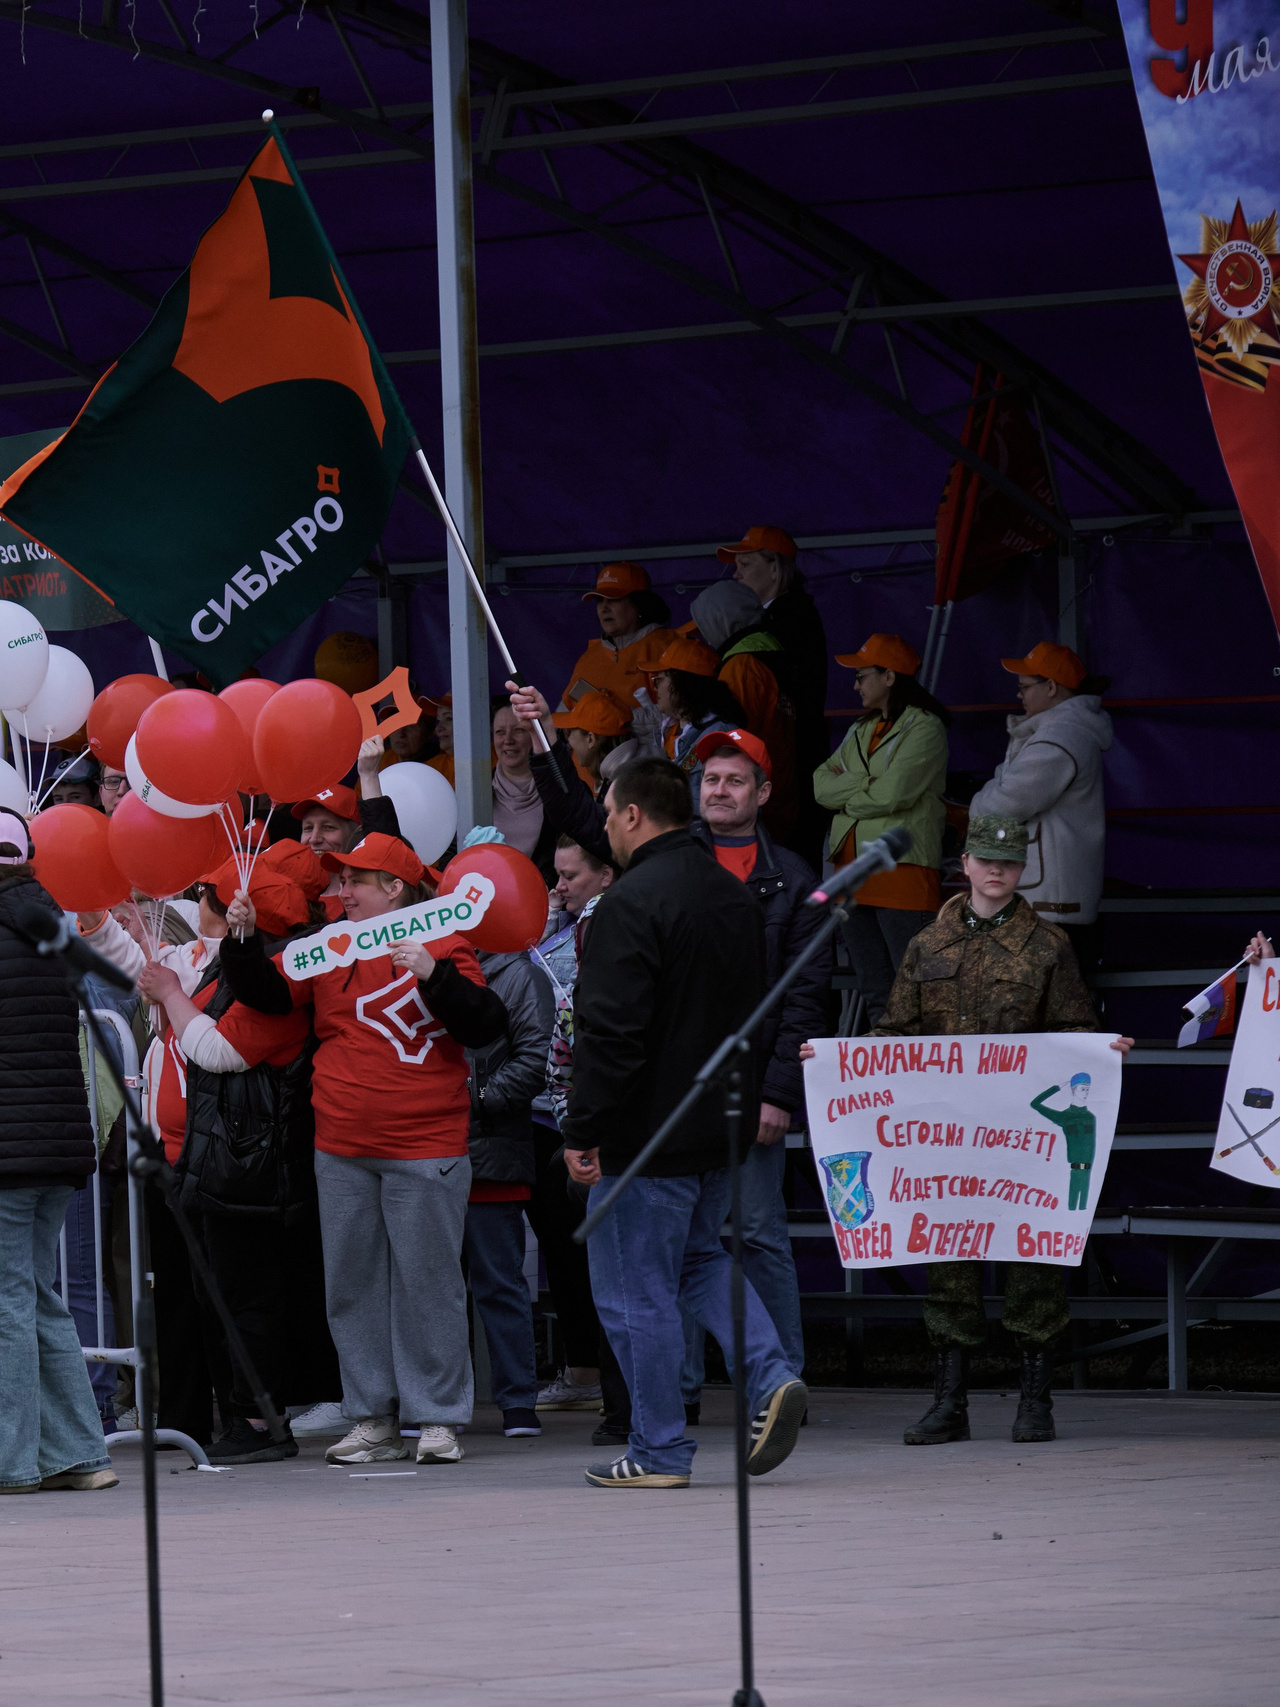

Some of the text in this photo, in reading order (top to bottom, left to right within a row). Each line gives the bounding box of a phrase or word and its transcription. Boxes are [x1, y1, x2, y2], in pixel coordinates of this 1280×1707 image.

[1176, 37, 1280, 104] мая
[1209, 243, 1266, 311] ОТЕЧЕСТВЕННАЯ
[190, 496, 344, 643] СИБАГРО
[8, 632, 43, 649] СИБАГРО
[293, 902, 473, 971] #Я СИБАГРО
[837, 1040, 1028, 1083] КОМАНДА НАША
